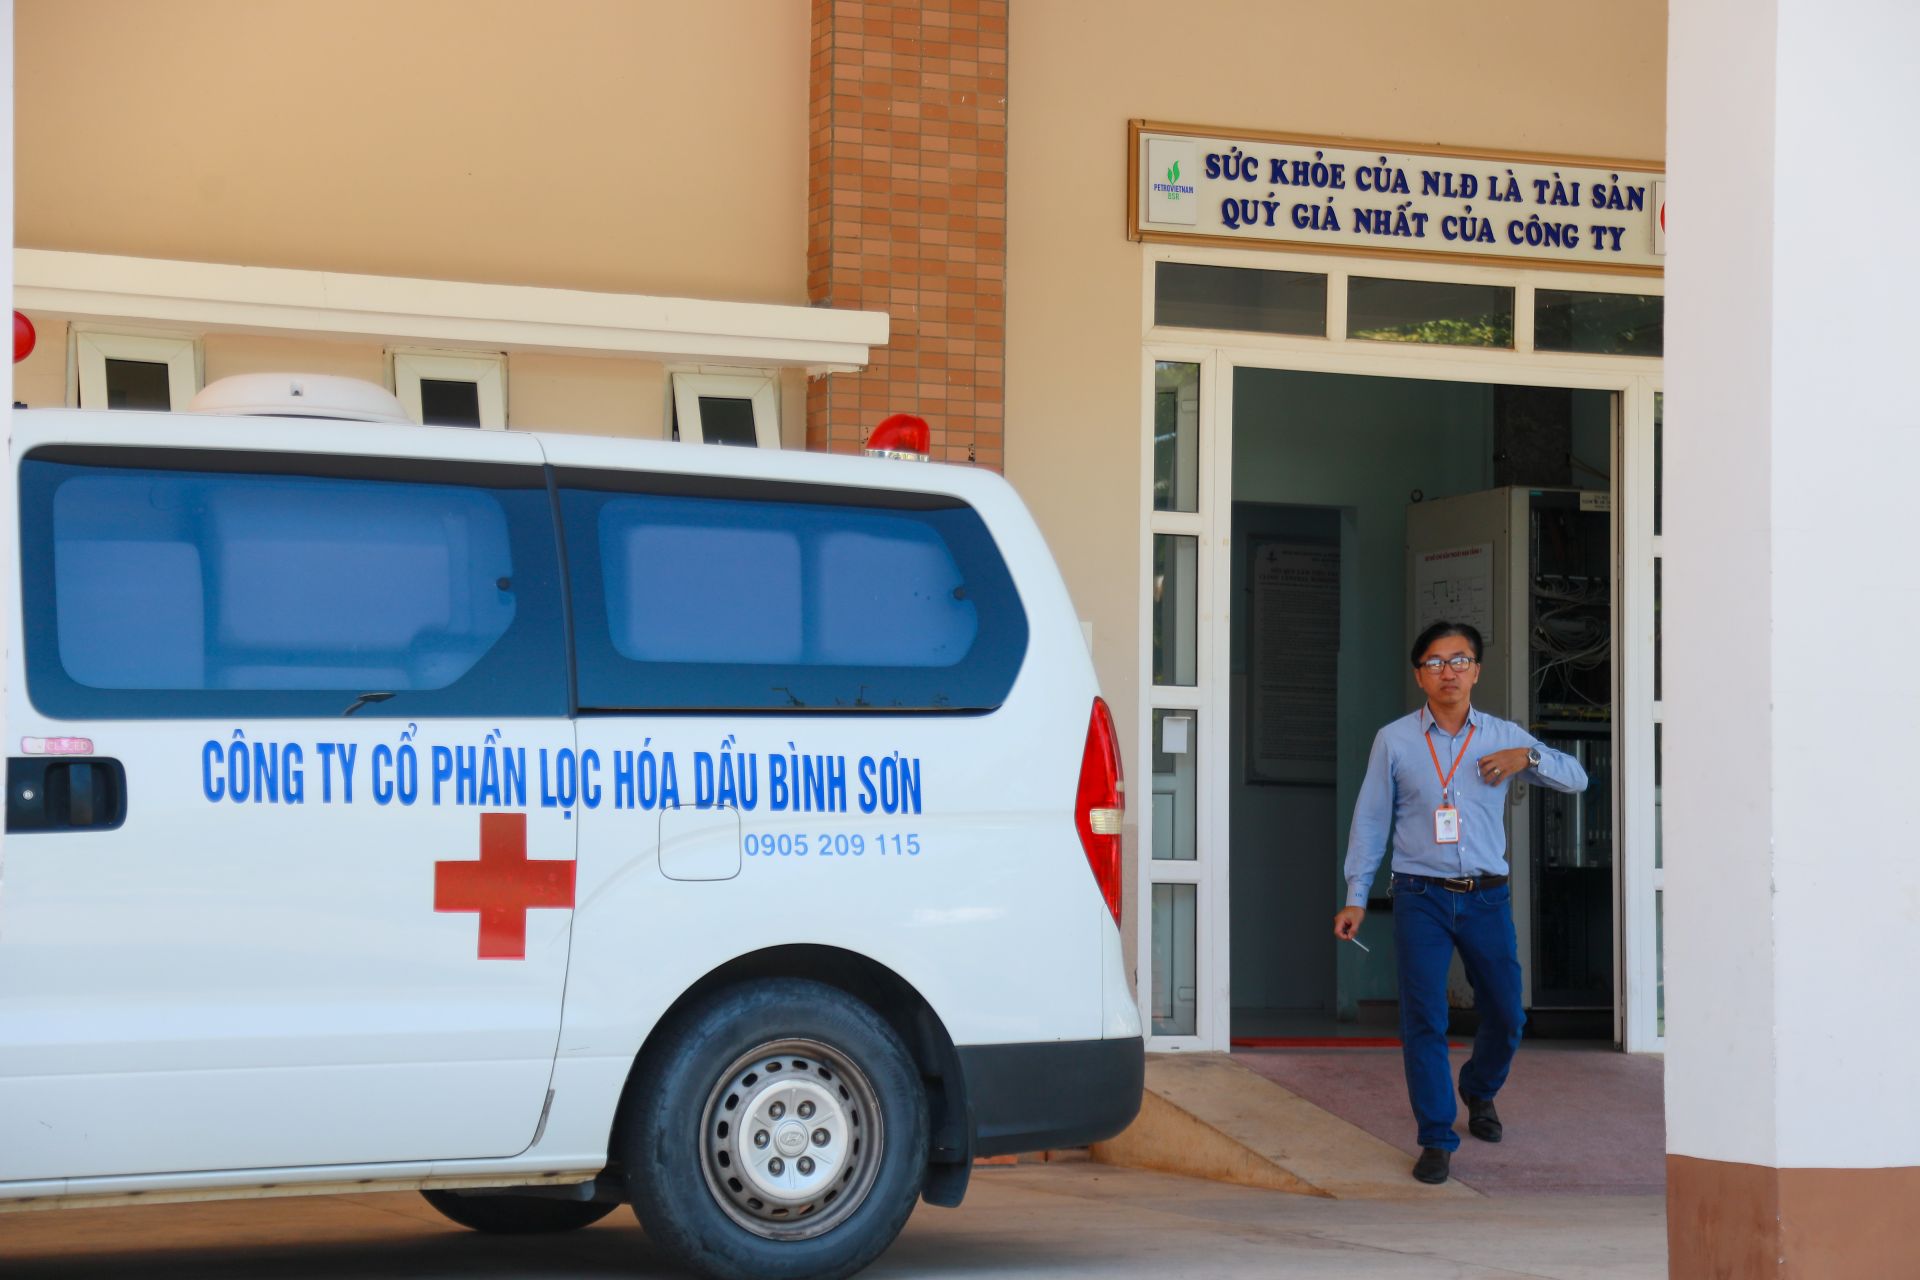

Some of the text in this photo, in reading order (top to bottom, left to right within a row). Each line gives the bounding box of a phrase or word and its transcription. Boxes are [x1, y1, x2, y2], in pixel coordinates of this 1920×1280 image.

[1153, 183, 1194, 194] PETROVIETNAM
[1167, 192, 1180, 200] BSR
[1205, 146, 1646, 211] SỨC KHỎE CỦA NLĐ LÀ TÀI SẢN
[1221, 191, 1626, 251] QUÝ GIÁ NHẤT CỦA CÔNG TY
[202, 722, 922, 820] CÔNG TY CỔ PHẦN LỌC HÓA DẦU BÌNH SƠN
[744, 833, 921, 856] 0905 209 115
